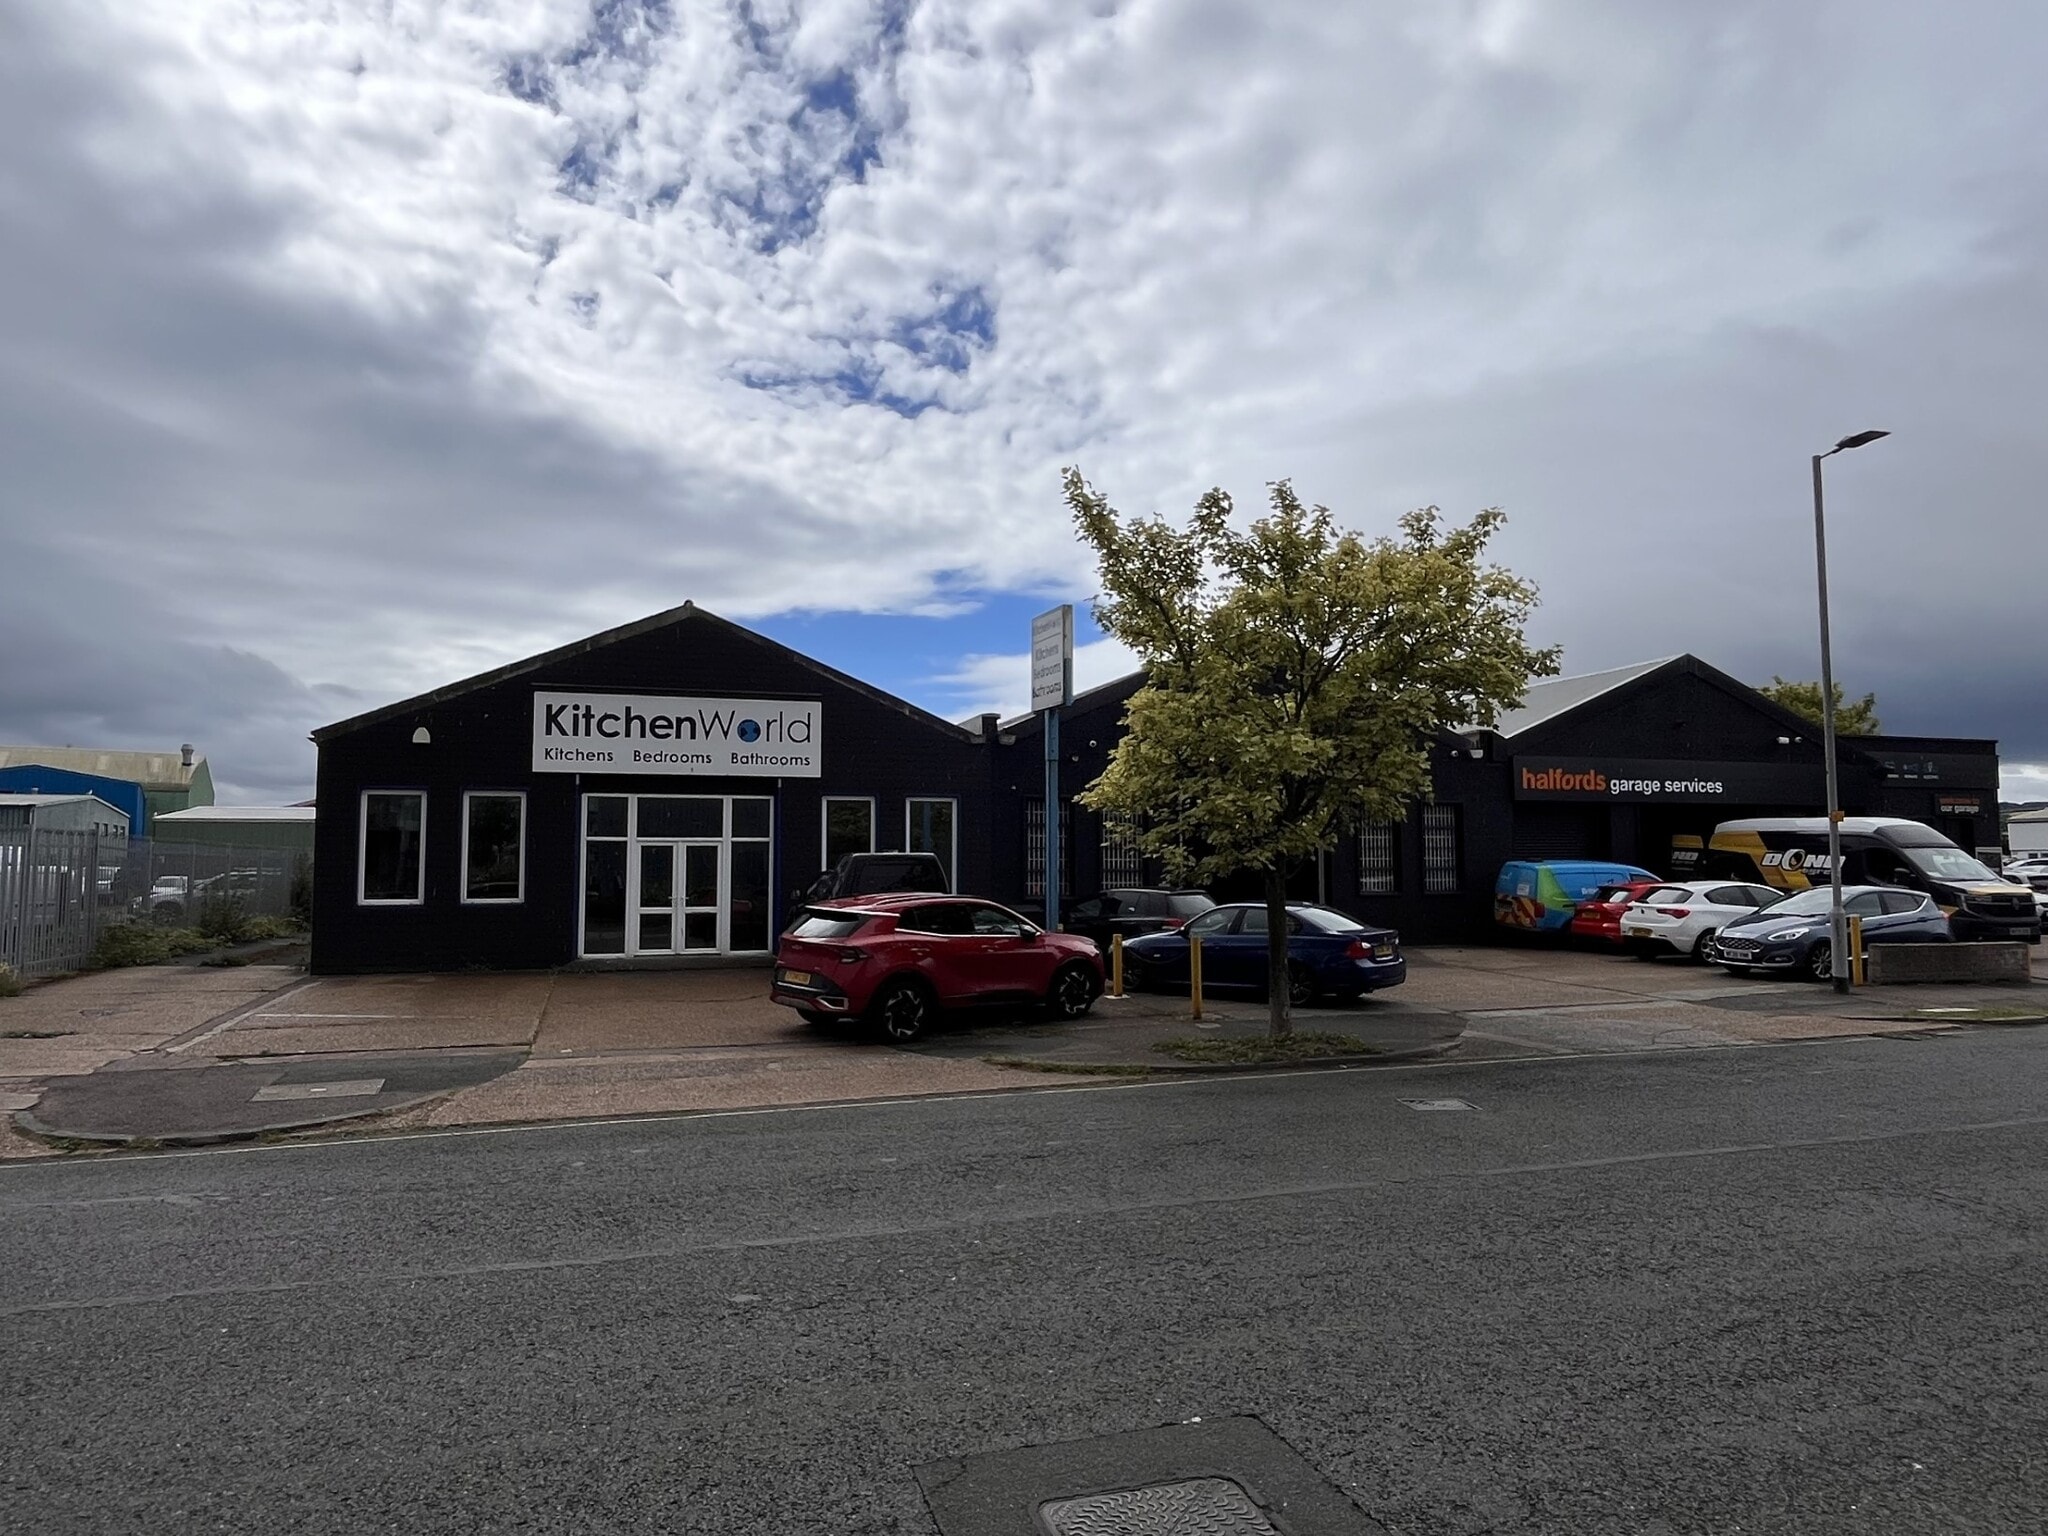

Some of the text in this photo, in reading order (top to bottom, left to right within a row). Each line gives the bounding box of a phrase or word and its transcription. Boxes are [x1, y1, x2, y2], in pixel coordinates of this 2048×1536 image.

[544, 703, 812, 744] KitchenWorld
[544, 747, 811, 767] Kitchens Bedrooms Bathrooms
[1522, 767, 1724, 795] halfords garage services
